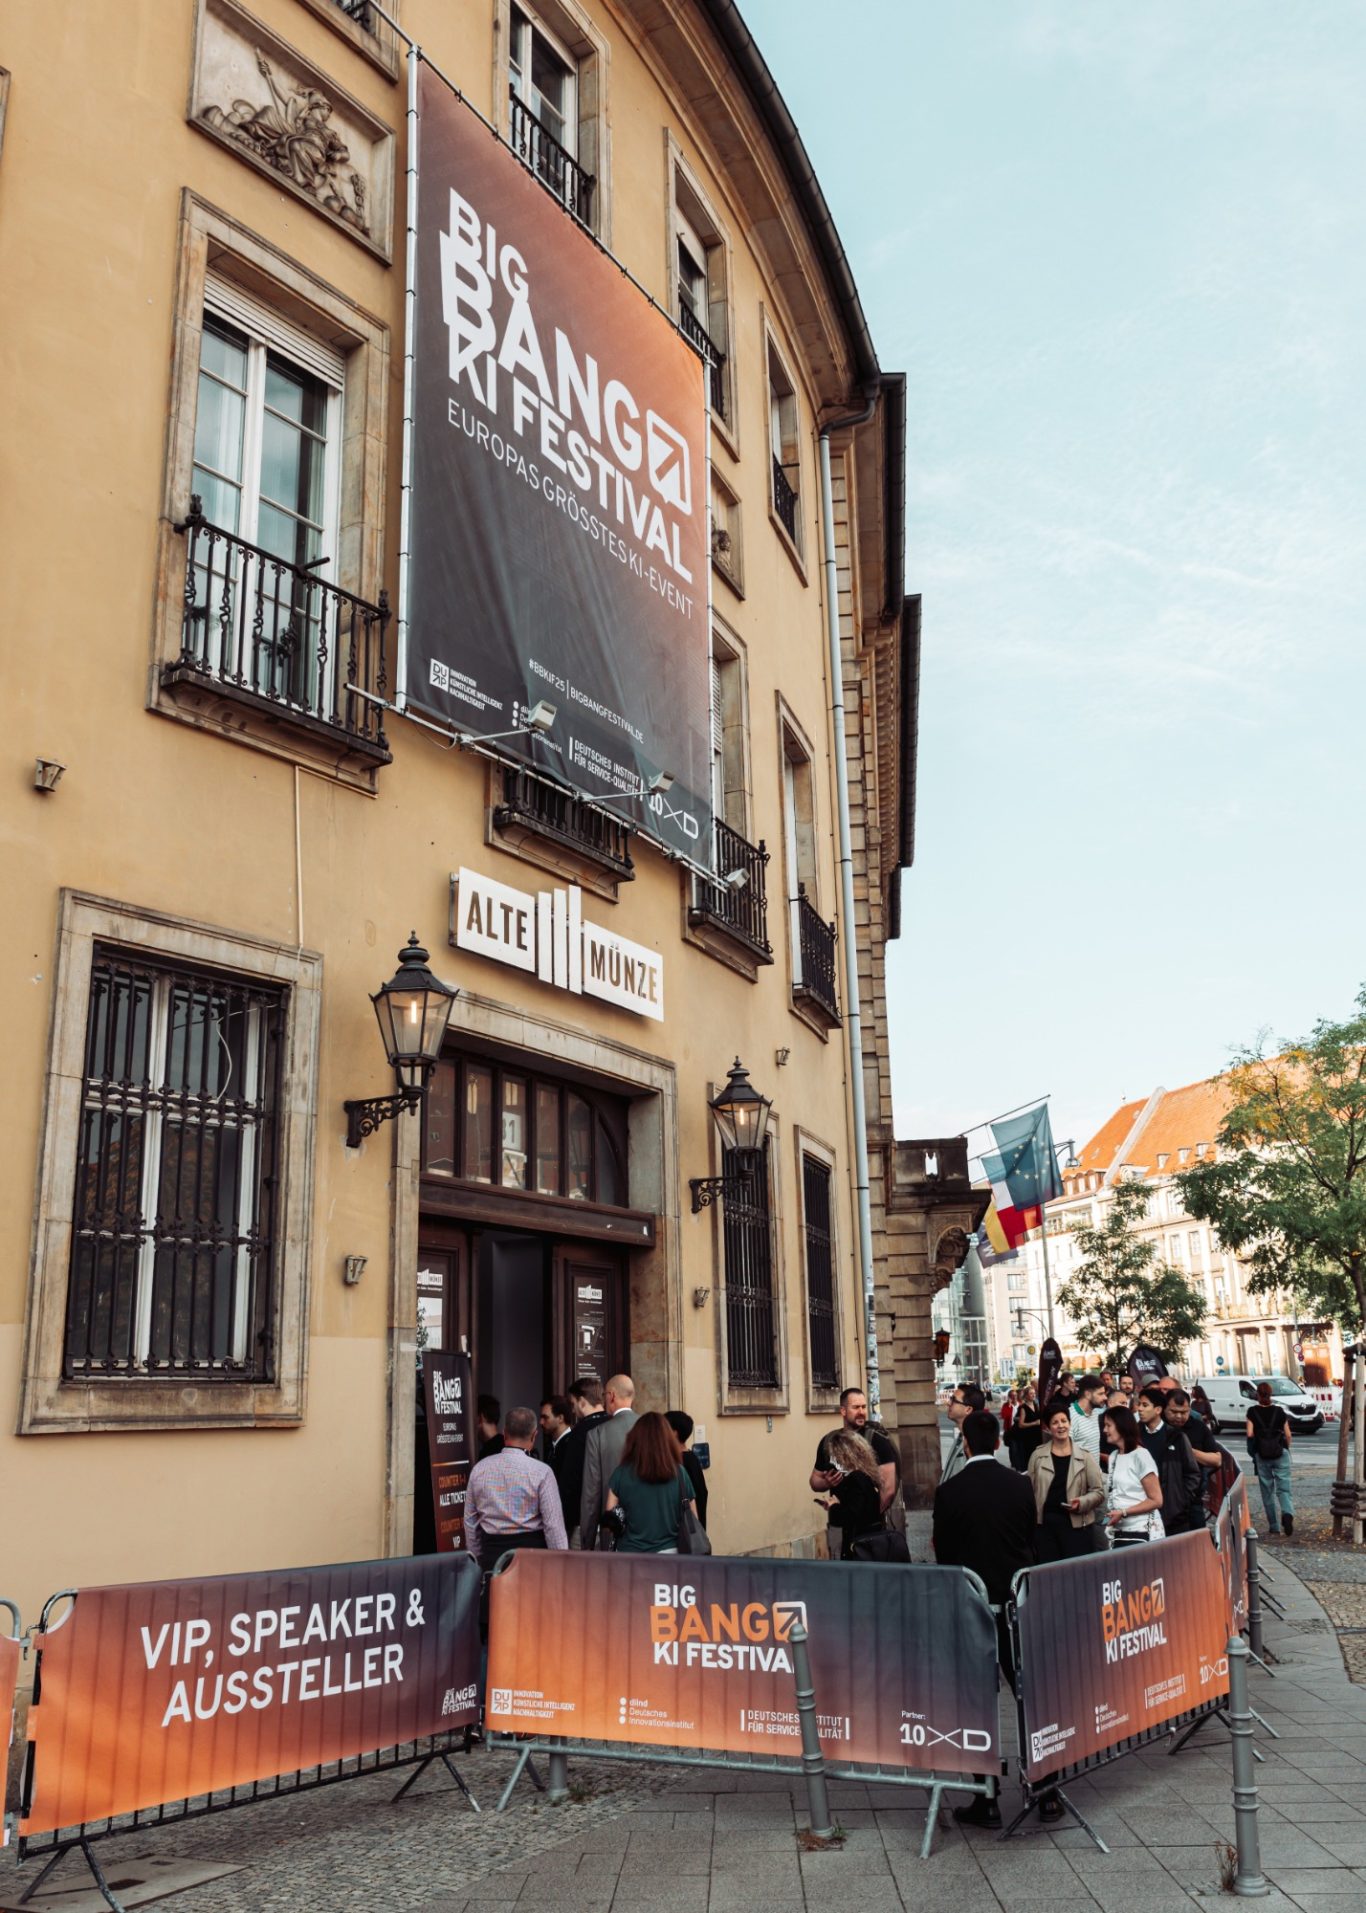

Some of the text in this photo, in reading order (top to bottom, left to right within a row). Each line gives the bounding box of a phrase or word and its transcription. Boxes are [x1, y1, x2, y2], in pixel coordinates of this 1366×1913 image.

[450, 187, 529, 303] BIG
[440, 230, 642, 471] BANG
[449, 322, 693, 584] KI FESTIVAL
[448, 397, 694, 619] EUROPAS GRÖSSTES KI-EVENT
[528, 658, 566, 692] #BBKIF25
[574, 740, 612, 769] DEUTSCHES
[466, 890, 658, 1004] ALTE MÜNZE
[653, 1582, 697, 1608] BIG
[1102, 1579, 1122, 1606] BIG
[141, 1587, 426, 1669] VIP, SPEAKER &
[650, 1601, 770, 1643] BANG
[1102, 1585, 1152, 1643] BANG
[653, 1640, 795, 1674] KI FESTIVA
[1105, 1622, 1168, 1665] KI FESTIVAL
[160, 1642, 406, 1728] AUSSTELLER
[448, 1699, 476, 1714] FESTIVAL
[629, 1708, 667, 1718] Deutsches
[748, 1710, 800, 1723] DEUTSCHES
[901, 1710, 926, 1721] Partner:
[748, 1721, 764, 1733] FÜR
